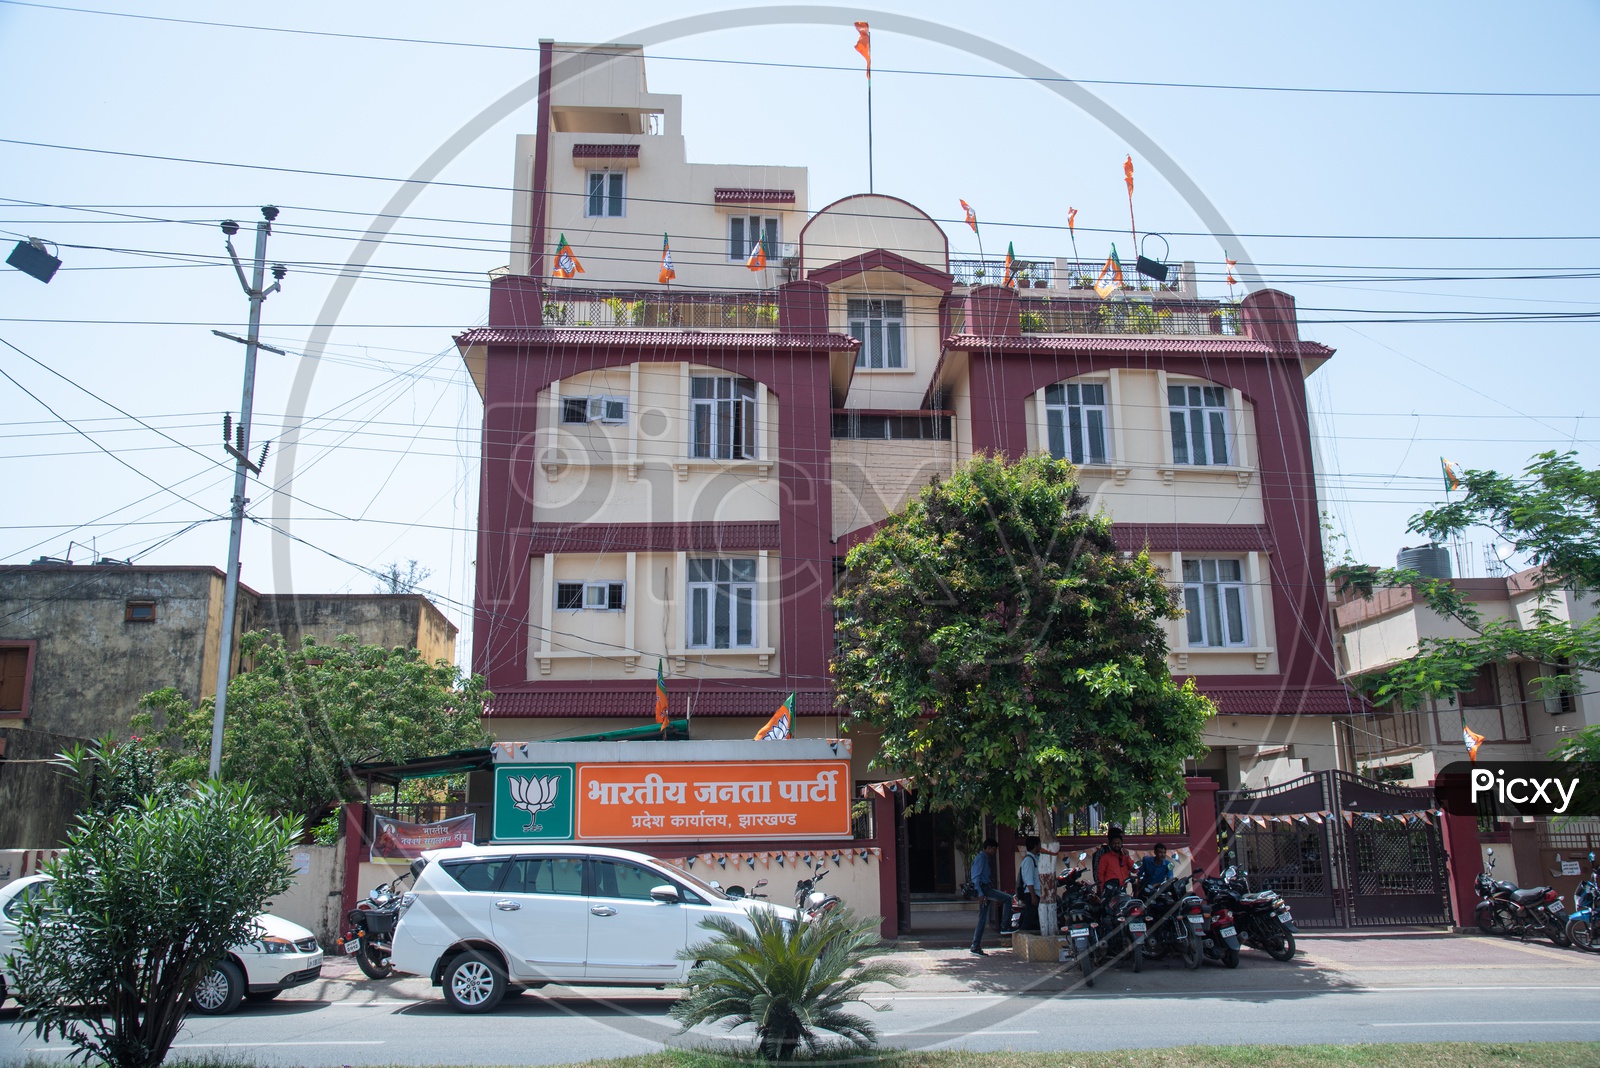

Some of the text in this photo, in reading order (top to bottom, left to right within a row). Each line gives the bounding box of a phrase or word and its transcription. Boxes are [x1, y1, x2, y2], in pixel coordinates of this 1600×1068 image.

[588, 770, 839, 805] भारतीय जनता पार्टी
[631, 810, 797, 828] प्रदेश कार्यालय, झारखण्ड
[423, 825, 449, 835] भारतीय
